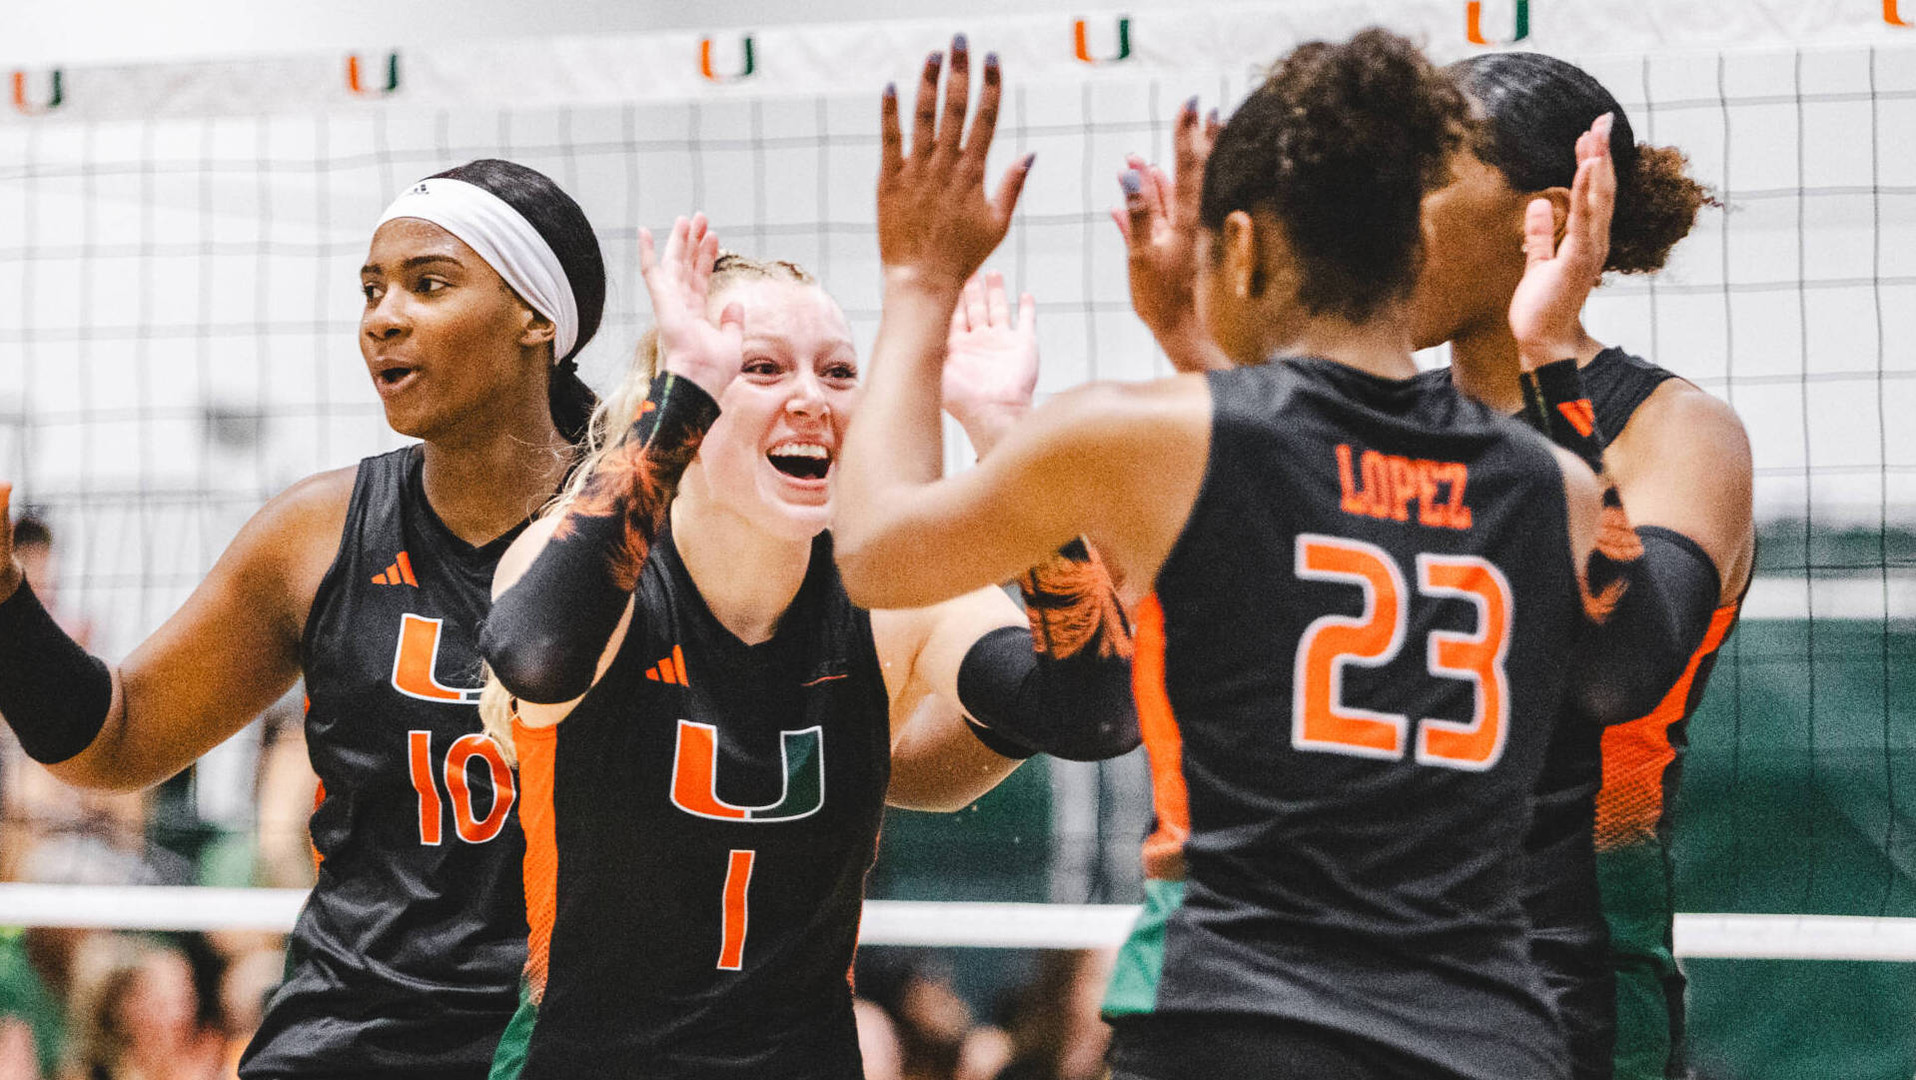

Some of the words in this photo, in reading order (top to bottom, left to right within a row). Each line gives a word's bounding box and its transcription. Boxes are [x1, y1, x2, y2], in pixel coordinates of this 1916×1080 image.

[1073, 17, 1131, 62] U
[1466, 0, 1531, 44] U
[345, 51, 401, 95] U
[699, 36, 754, 79] U
[11, 70, 63, 112] U
[1336, 443, 1472, 529] LOPEZ
[1291, 533, 1514, 771] 23
[408, 730, 516, 845] 10
[670, 719, 825, 822] U
[716, 849, 756, 971] 1
